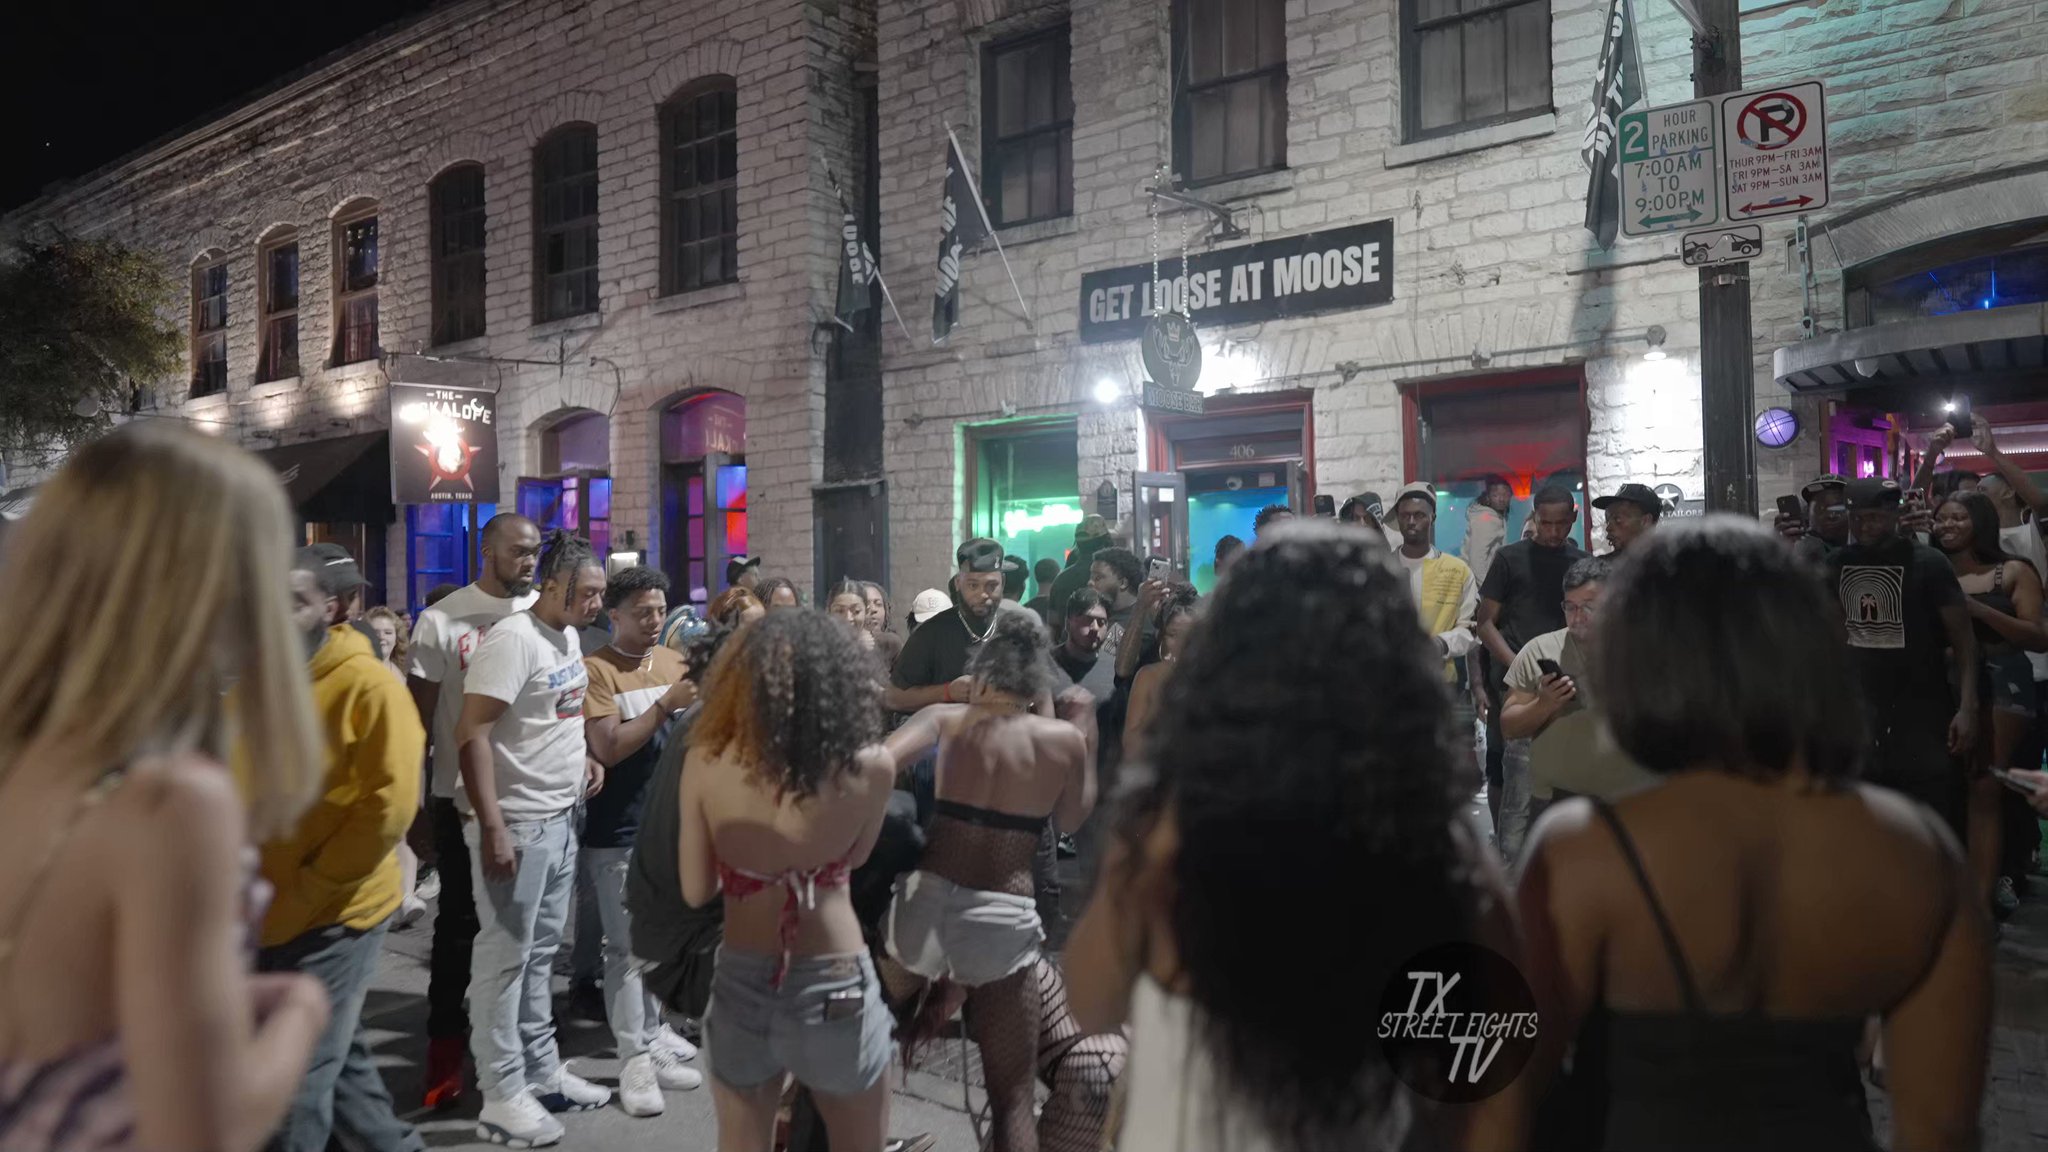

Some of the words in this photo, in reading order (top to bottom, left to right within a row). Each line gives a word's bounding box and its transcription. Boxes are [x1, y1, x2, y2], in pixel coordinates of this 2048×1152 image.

[1664, 110, 1696, 127] HOUR
[1624, 121, 1644, 154] 2
[1652, 127, 1708, 150] PARKING
[1634, 153, 1702, 178] 7:00AM
[1730, 157, 1754, 169] THUR
[1802, 146, 1822, 157] 3AM
[1733, 171, 1748, 180] FRI
[1799, 161, 1819, 171] 3AM
[1657, 175, 1680, 193] TO
[1731, 183, 1747, 194] SAT
[1802, 173, 1823, 183] 3AM
[1635, 188, 1704, 213] 9:00PM
[1090, 283, 1134, 324] GET
[1141, 269, 1222, 317] LOOSE
[1229, 261, 1264, 304] AT
[1273, 242, 1380, 297] MOOSE
[435, 390, 454, 400] THE
[1231, 444, 1255, 458] 406
[1666, 509, 1703, 518] TAILORS
